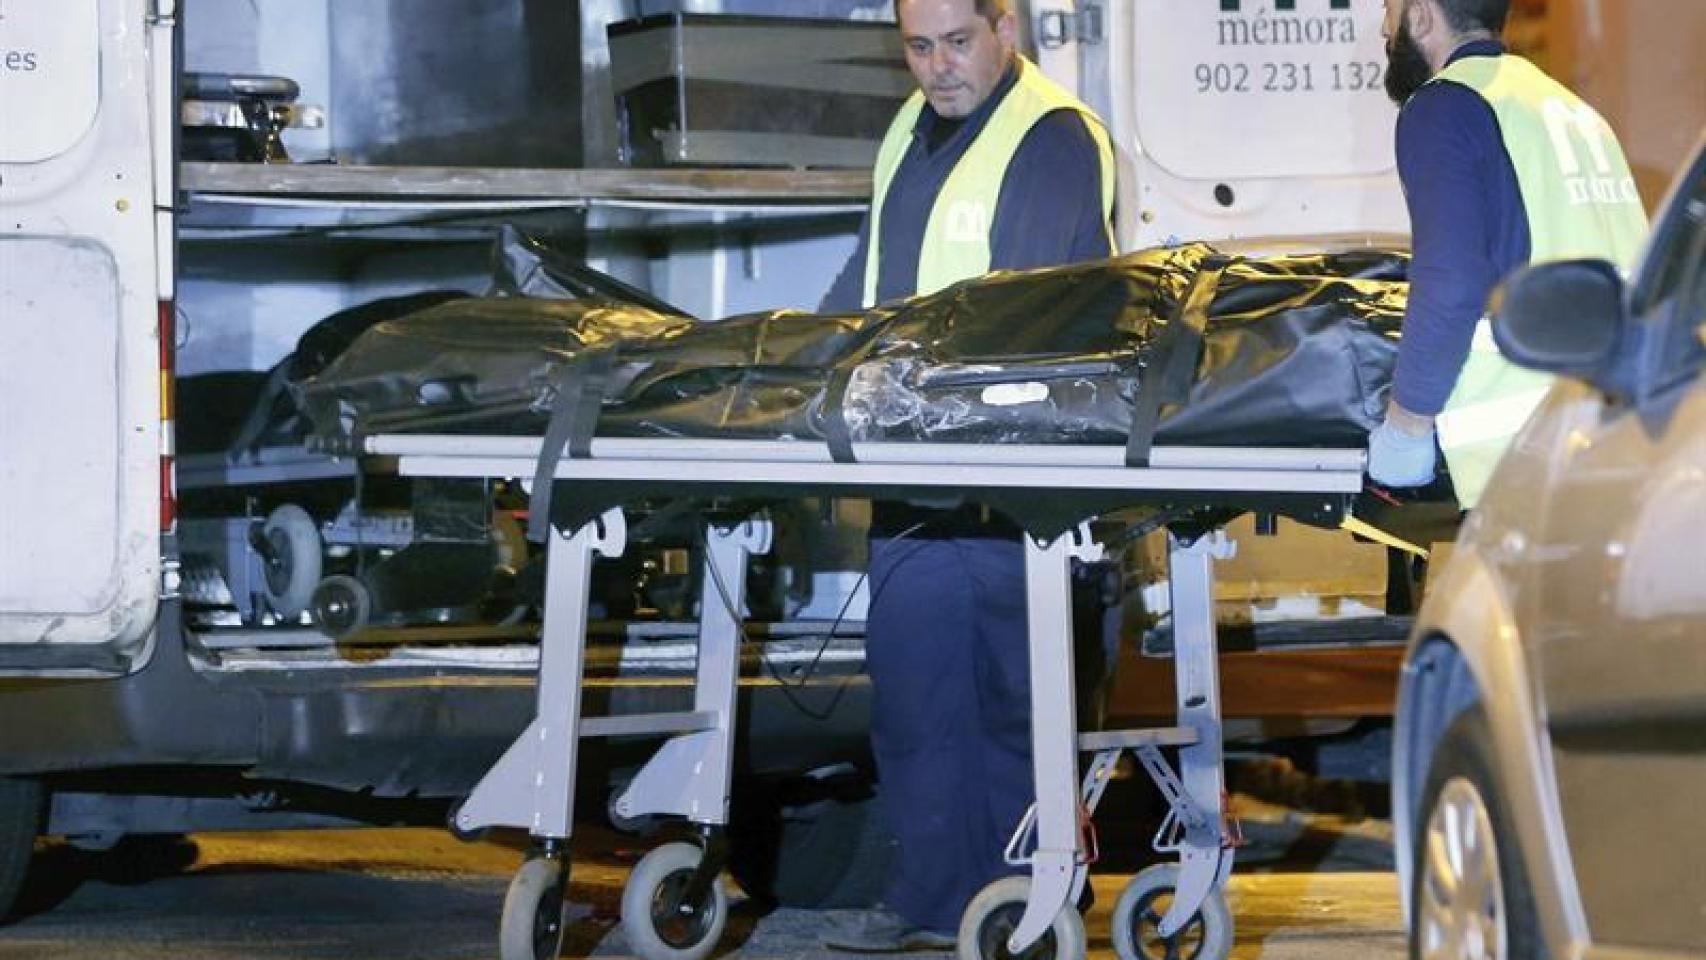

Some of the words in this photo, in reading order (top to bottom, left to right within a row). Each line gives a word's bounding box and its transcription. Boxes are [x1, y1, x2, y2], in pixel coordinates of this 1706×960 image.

[1217, 8, 1356, 46] mémora
[1195, 63, 1250, 92] 902
[1263, 63, 1314, 92] 231
[1331, 62, 1382, 91] 132
